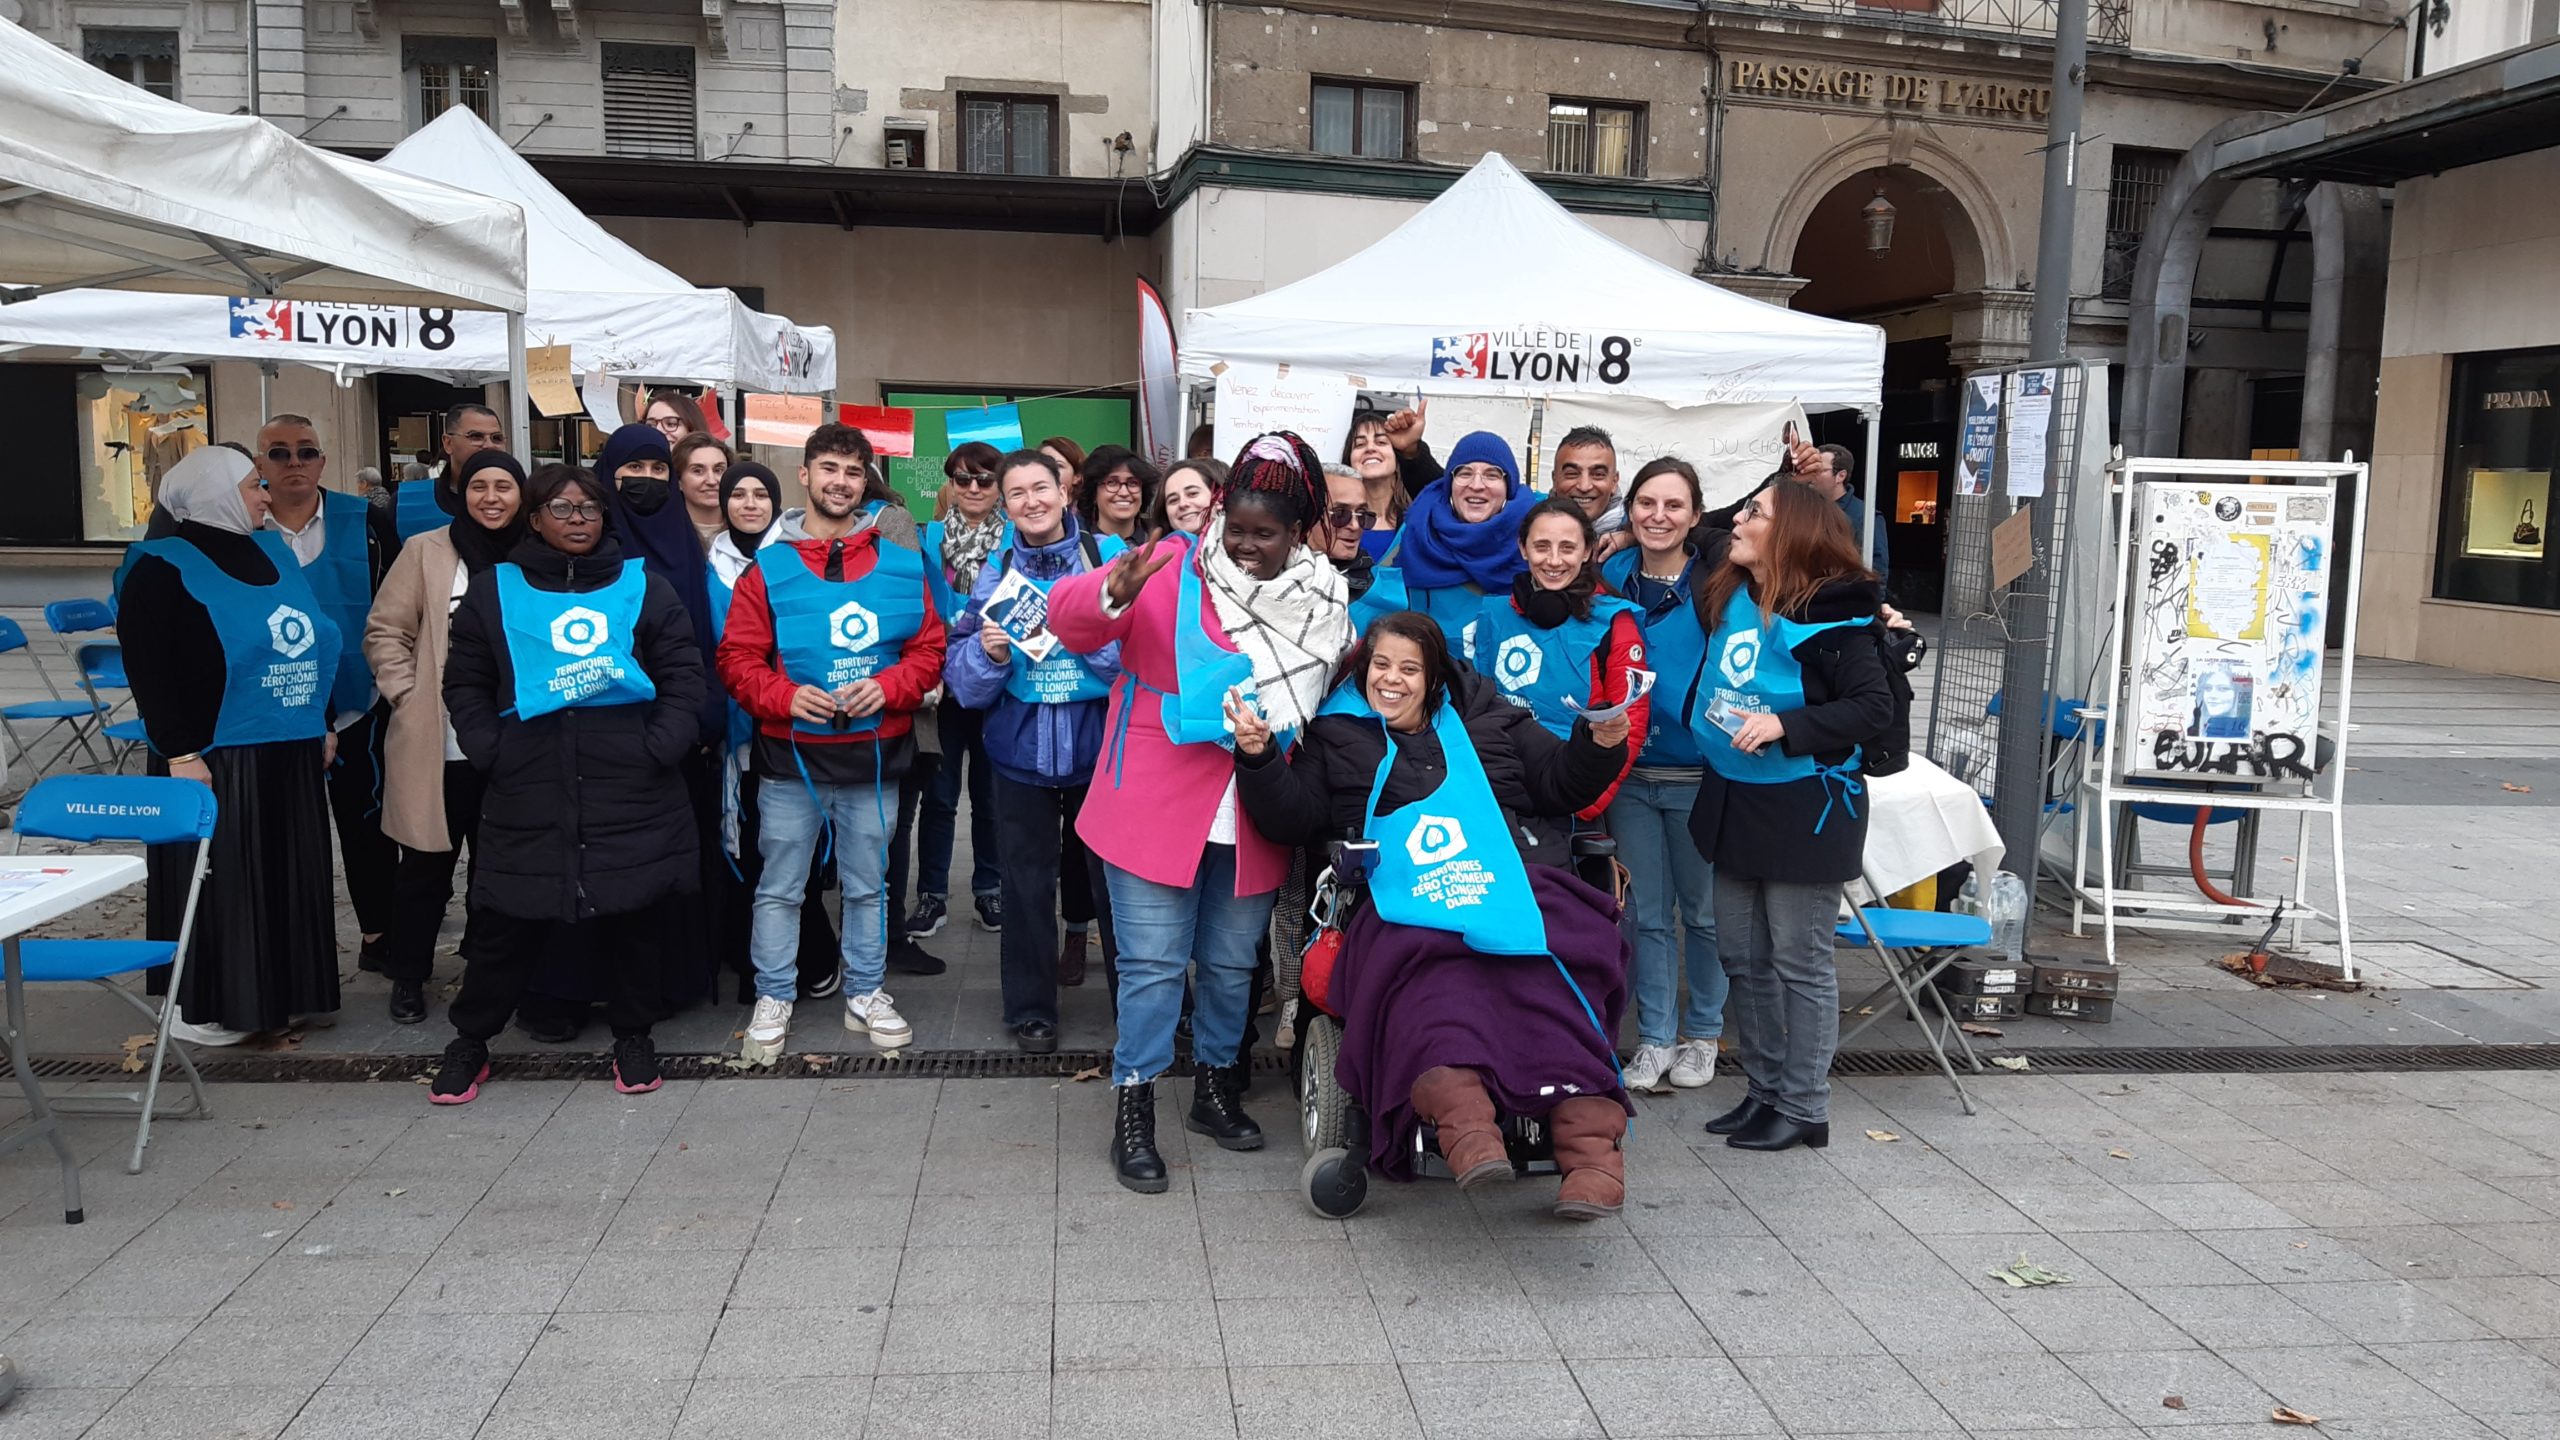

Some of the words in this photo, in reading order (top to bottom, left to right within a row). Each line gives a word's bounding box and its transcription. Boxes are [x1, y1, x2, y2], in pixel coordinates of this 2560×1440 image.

[1733, 59, 1874, 99] PASSAGE
[1889, 74, 1929, 103] DE
[1940, 79, 2050, 114] L'ARGU
[297, 311, 397, 348] LYON
[1492, 331, 1548, 348] VILLE
[1555, 332, 1581, 350] DE
[1490, 351, 1580, 383] LYON
[2484, 389, 2552, 409] PRADA
[268, 660, 318, 676] TERRITOIRES
[555, 656, 615, 677] TERRITOIRES
[261, 674, 286, 687] ZÉRO
[827, 667, 848, 683] ZÉRO
[547, 675, 576, 692] ZÉRO
[1035, 682, 1043, 692] DE
[1044, 680, 1079, 693] LONGUE
[272, 687, 284, 698] DE
[563, 687, 578, 702] DE
[1042, 692, 1071, 704] DURÉE
[282, 694, 312, 708] DURÉE
[66, 803, 107, 815] VILLE
[108, 804, 127, 816] DE
[129, 805, 161, 816] LYON
[1411, 878, 1441, 897] ZÉRO
[1428, 889, 1445, 903] DE
[1445, 883, 1488, 898] LONGUE
[1445, 895, 1483, 910] DURÉE
